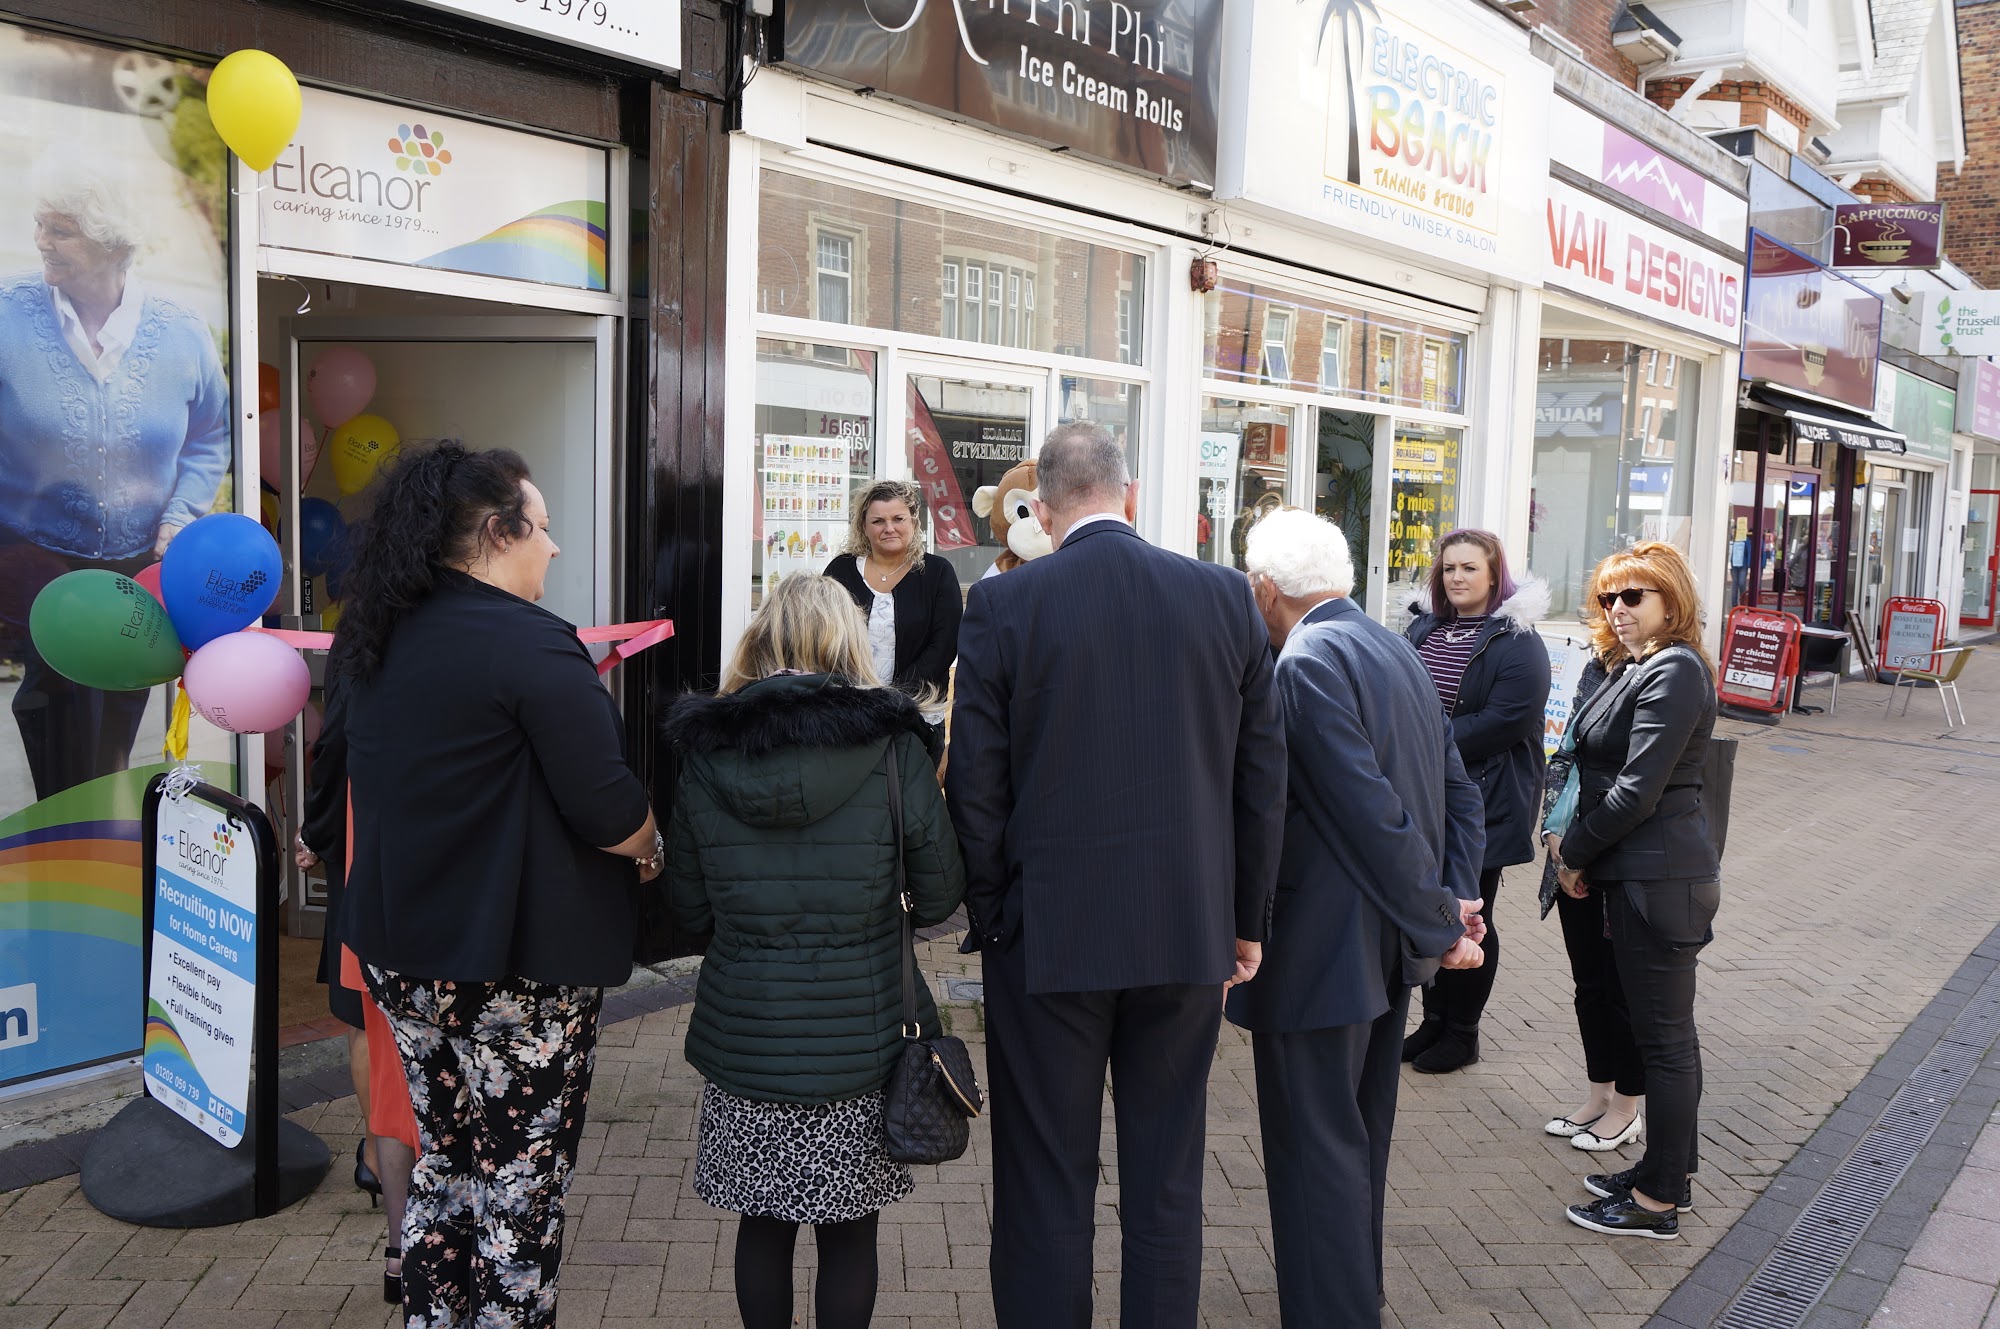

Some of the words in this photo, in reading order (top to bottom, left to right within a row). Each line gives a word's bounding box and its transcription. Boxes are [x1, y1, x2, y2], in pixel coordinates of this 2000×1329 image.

[1107, 0, 1166, 75] Phi
[1019, 44, 1054, 88] Ice
[1062, 59, 1128, 114] Cream
[1135, 87, 1184, 133] Rolls
[1372, 26, 1497, 127] ELECTRIC
[273, 143, 431, 213] Eleanor
[1374, 167, 1426, 202] TANNING
[1434, 188, 1475, 218] STUDIO
[273, 199, 335, 223] caring
[338, 208, 382, 225] since
[1323, 184, 1397, 221] FRIENDLY
[1402, 212, 1452, 240] UNISEX
[1456, 229, 1497, 254] SALON
[1838, 208, 1940, 225] CAPPUCCINO'S
[1546, 197, 1615, 286] NAIL
[1625, 232, 1738, 328] DESIGNS
[1956, 326, 1984, 336] trust
[1957, 316, 2000, 327] trussell
[1958, 306, 1978, 317] the
[1444, 439, 1458, 459] £2
[1443, 467, 1457, 486] £3
[1396, 492, 1405, 511] 8
[1407, 492, 1435, 512] mins
[1441, 494, 1455, 512] £4
[1389, 520, 1404, 540] 10
[1406, 520, 1434, 540] mins
[1388, 549, 1403, 567] 12
[1404, 548, 1433, 567] mins
[120, 587, 147, 639] Eleanor
[1735, 629, 1756, 638] roast
[1757, 631, 1780, 643] lamb,
[1746, 648, 1776, 660] chicken
[1759, 641, 1779, 651] beef
[178, 860, 197, 878] caring
[179, 829, 228, 876] Eleanor
[159, 877, 217, 930] Recruiting
[219, 907, 254, 943] NOW
[169, 914, 182, 932] for
[182, 920, 208, 947] Home
[208, 935, 238, 963] Carers
[173, 952, 206, 981] Excellent
[207, 973, 222, 991] pay
[171, 975, 200, 1001] Flexible
[200, 992, 223, 1015] hours
[170, 999, 184, 1017] Full
[184, 1007, 212, 1037] training
[213, 1027, 236, 1048] given
[155, 1062, 175, 1084] 01202
[174, 1075, 187, 1093] 059
[187, 1083, 200, 1101] 739
